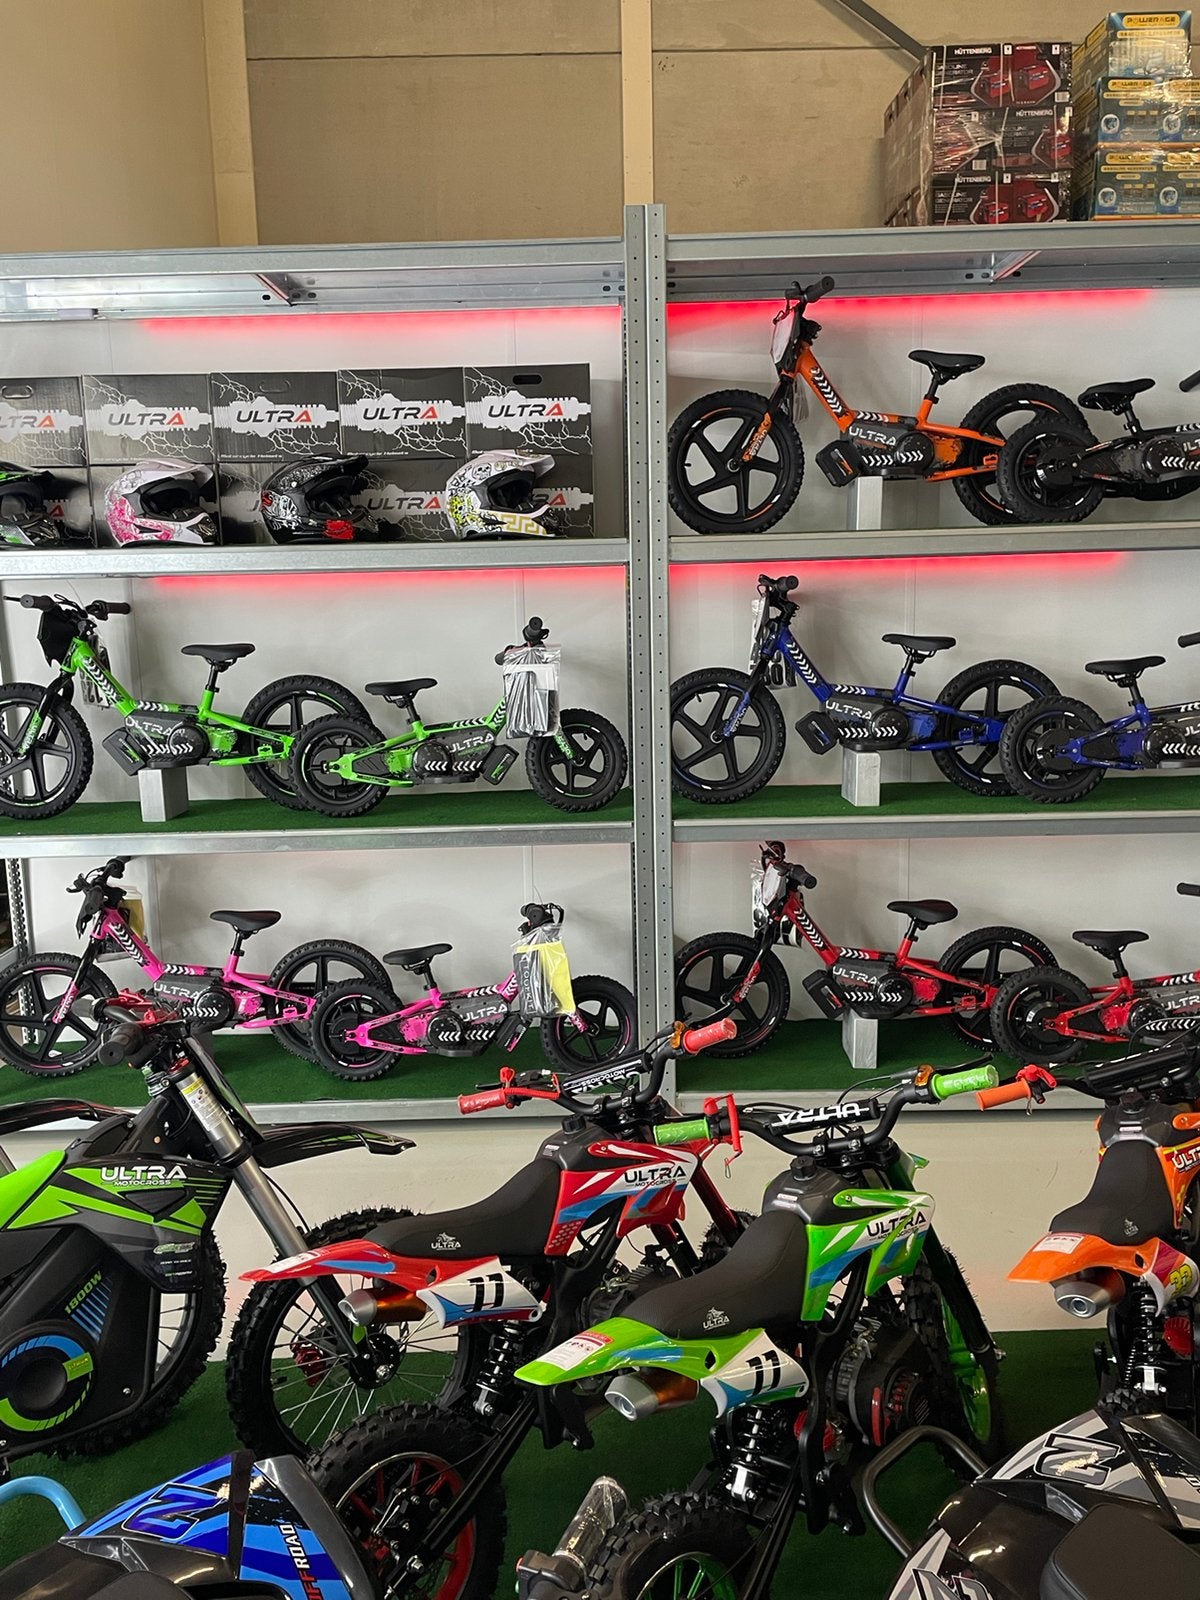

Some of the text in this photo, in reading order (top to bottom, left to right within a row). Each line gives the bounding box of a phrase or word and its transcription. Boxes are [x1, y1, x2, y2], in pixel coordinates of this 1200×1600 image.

[108, 412, 184, 426] ULTRA
[236, 409, 312, 424] ULTRA
[362, 406, 438, 420] ULTRA
[487, 403, 564, 418] ULTRA
[0, 415, 55, 428] LTRA
[848, 425, 897, 446] ULTRA
[367, 496, 441, 510] ULTRA
[825, 700, 873, 720] ULTRA
[125, 715, 172, 737] ULTRA
[446, 732, 495, 753] ULTRA
[832, 965, 878, 985] ULTRA
[153, 981, 200, 1001] ULTRA
[1161, 995, 1200, 1010] ULTR
[460, 1003, 508, 1022] ULTRA
[1172, 1145, 1200, 1169] ULT
[101, 1165, 188, 1181] ULTRA
[624, 1165, 687, 1184] ULTRA
[113, 1179, 171, 1187] MOTOCROSS
[431, 1241, 462, 1250] ULTRA
[64, 1270, 102, 1314] 1800W
[466, 1272, 505, 1314] 11
[702, 1315, 730, 1329] ULTRA
[745, 1349, 782, 1398] 11
[279, 1524, 323, 1600] FF ROAD
